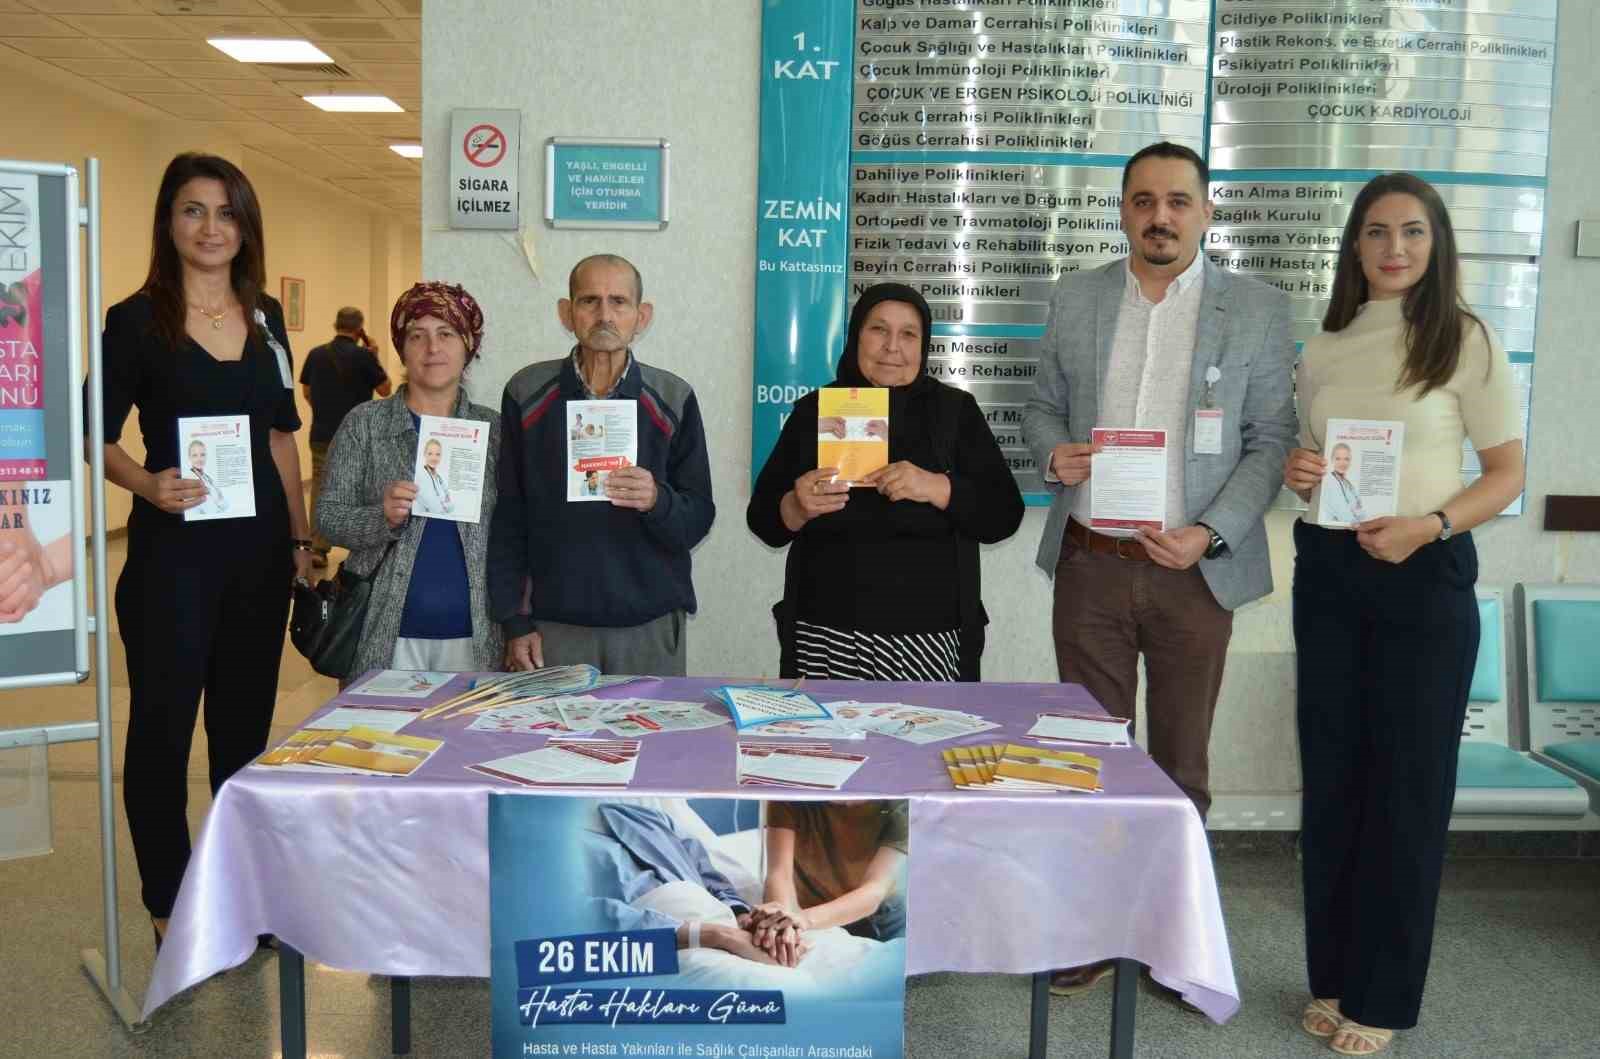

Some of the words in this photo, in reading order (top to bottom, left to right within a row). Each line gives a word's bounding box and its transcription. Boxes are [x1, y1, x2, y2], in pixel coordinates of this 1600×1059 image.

[861, 18, 897, 32] Kalp
[902, 20, 921, 30] ve
[926, 17, 978, 29] Damar
[984, 17, 1057, 31] Cerrahisi
[1221, 13, 1278, 27] Cildiye
[792, 31, 821, 51] 1.
[1220, 36, 1271, 48] Plastik
[1276, 35, 1336, 48] Rekons.
[1342, 38, 1358, 48] ve
[1417, 38, 1466, 52] Cerrahi
[860, 41, 911, 56] Çocuk
[917, 41, 972, 56] Sağlığı
[977, 42, 996, 53] ve
[1002, 41, 1088, 55] Hastalıkları
[1096, 44, 1188, 63] Poliklinikleri
[774, 59, 840, 80] KAT
[915, 61, 1006, 79] İmmünoloji
[1012, 64, 1110, 80] Poliklinikleri
[1218, 58, 1294, 73] Psikiyatri
[1300, 58, 1399, 71] Poliklinikleri
[867, 87, 923, 104] ÇOCUK
[930, 87, 950, 99] VE
[955, 87, 1012, 99] ERGEN
[1217, 81, 1271, 97] Üroloji
[1277, 82, 1377, 96] Poliklinikleri
[858, 111, 909, 125] Çocuk
[915, 111, 987, 123] Cerrahisi
[994, 111, 1092, 126] Poliklinikleri
[1308, 104, 1365, 119] ÇOCUK
[1370, 104, 1471, 121] KARDİYOLOJİ
[916, 134, 989, 146] Cerrahisi
[995, 134, 1093, 149] Poliklinikleri
[568, 174, 582, 183] VE
[856, 168, 919, 183] Dahiliye
[925, 168, 1025, 182] Poliklinikleri
[459, 177, 508, 192] SİGARA
[596, 187, 641, 196] OTURMA
[1212, 187, 1244, 199] Kan
[1248, 186, 1290, 199] Alma
[1295, 186, 1343, 199] Birimi
[457, 198, 511, 214] İÇİLMEZ
[856, 191, 900, 204] Kadın
[906, 191, 996, 204] Hastalıkları
[1001, 194, 1020, 205] ve
[1025, 192, 1082, 209] Doğum
[764, 196, 841, 221] ZEMİN
[1212, 209, 1261, 224] Sağlık
[1267, 209, 1321, 221] Kurulu
[856, 214, 924, 229] Ortopedi
[930, 217, 948, 228] ve
[953, 214, 1051, 232] Travmatoloji
[1058, 217, 1121, 231] Poliklini
[778, 228, 828, 248] KAT
[854, 237, 890, 250] Fizik
[896, 237, 947, 250] Tedavi
[952, 241, 970, 250] ve
[977, 239, 1094, 255] Rehabilitasyon
[1100, 242, 1128, 255] Poli
[1210, 232, 1280, 247] Danışma
[1286, 231, 1341, 246] Yönlen
[760, 259, 775, 272] Bu
[854, 260, 898, 275] Beyin
[904, 260, 976, 273] Cerrahisi
[1210, 255, 1264, 270] Engelli
[1270, 256, 1315, 270] Hasta
[921, 283, 1020, 298] Poliklinikleri
[951, 342, 1008, 354] Mescid
[0, 364, 37, 382] ARI
[949, 369, 967, 377] ve
[972, 364, 1037, 377] Rehabili
[1, 383, 38, 405] NÜ
[757, 385, 815, 404] BODR
[0, 488, 51, 506] KINIZ
[1, 512, 24, 529] AR
[538, 940, 576, 973] 26
[584, 936, 655, 973] EKİM
[519, 985, 593, 1029] Hasta
[599, 985, 700, 1029] Hakları
[707, 990, 781, 1024] Günü
[522, 1041, 559, 1055] Hasta
[563, 1044, 578, 1055] ve
[582, 1041, 616, 1055] Hasta
[622, 1042, 674, 1055] Yakınları
[696, 1043, 735, 1059] Sağlık
[738, 1043, 804, 1059] Çalışanları
